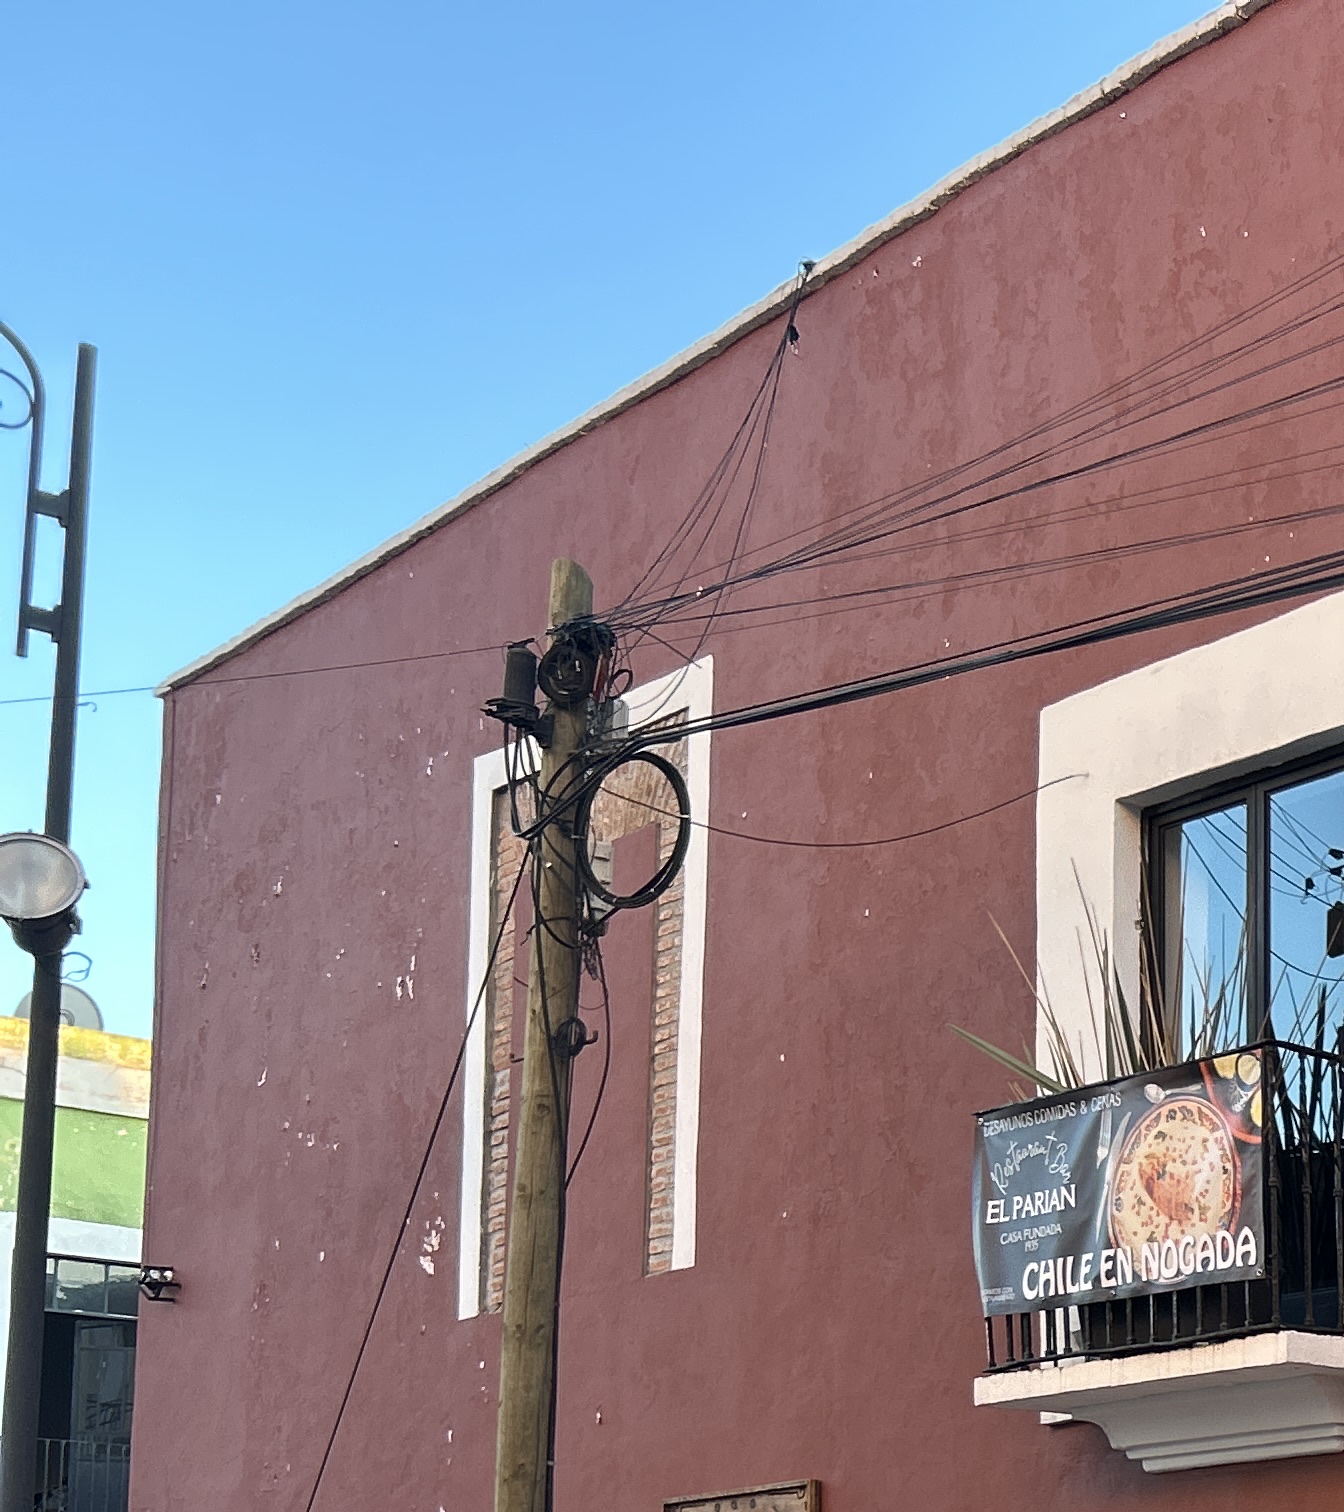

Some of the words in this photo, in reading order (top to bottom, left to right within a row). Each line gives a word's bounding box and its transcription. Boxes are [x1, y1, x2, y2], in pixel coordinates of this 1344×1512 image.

[983, 1112, 1034, 1137] DESAYUNOS
[1034, 1101, 1077, 1126] COMIDAS
[1079, 1100, 1088, 1115] &
[1090, 1091, 1122, 1113] CENAS
[985, 1199, 1010, 1224] EL
[1012, 1183, 1076, 1221] PARIAN
[1000, 1231, 1022, 1245] CASA
[1023, 1223, 1063, 1240] FUNDADA
[1022, 1252, 1094, 1301] CHILE
[1099, 1245, 1133, 1290] EN
[1141, 1225, 1257, 1283] NOGADA
